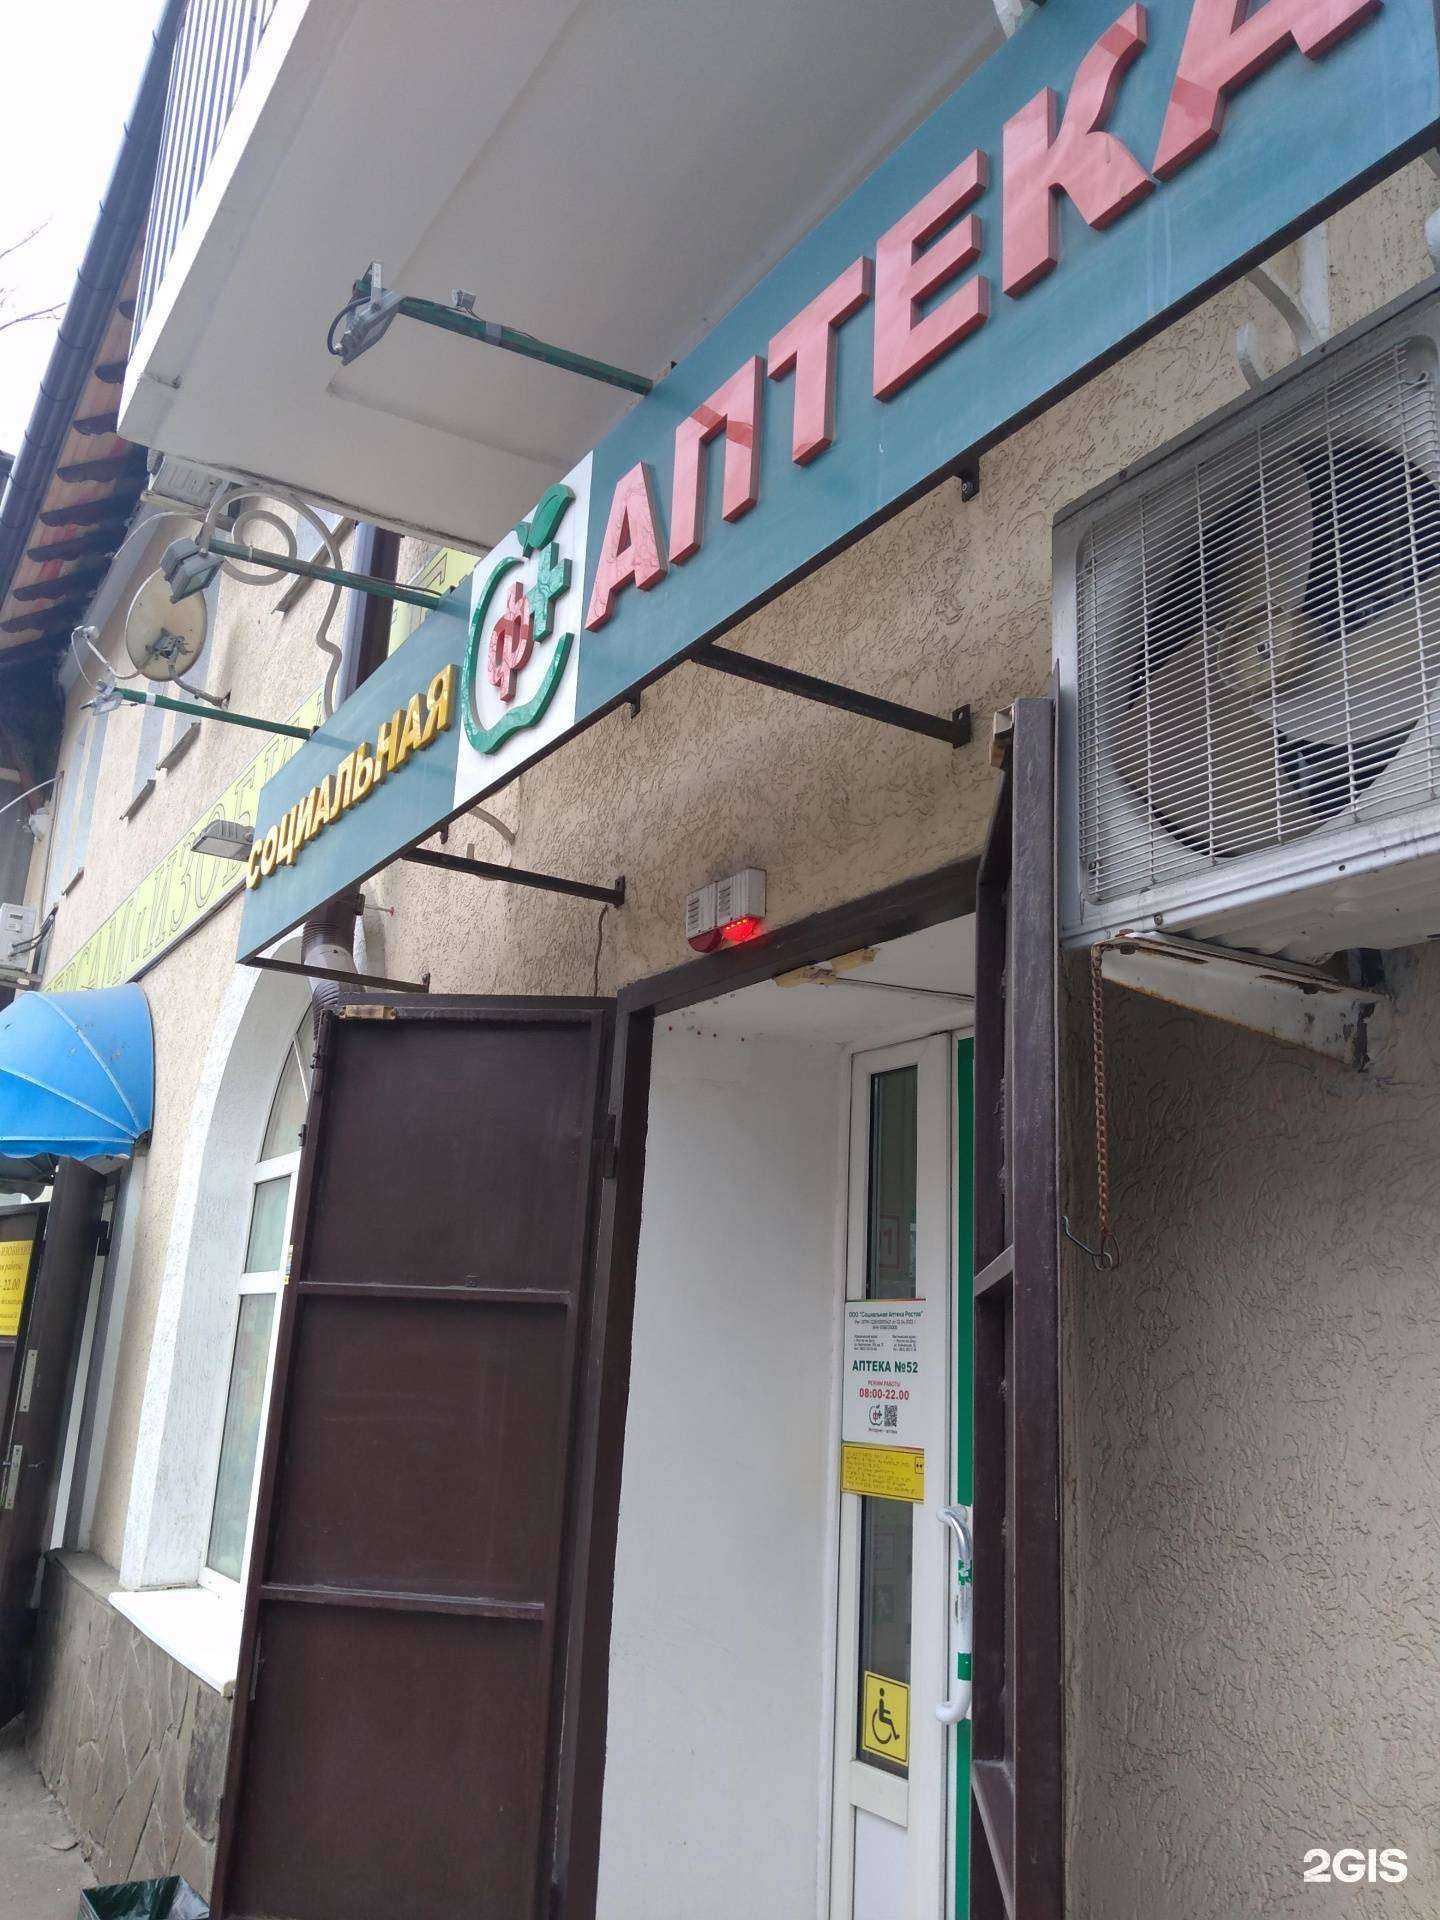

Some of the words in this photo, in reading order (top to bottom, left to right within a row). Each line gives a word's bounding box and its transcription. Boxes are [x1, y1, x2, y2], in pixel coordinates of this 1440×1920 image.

[586, 0, 1384, 633] АПТЕКА
[246, 664, 460, 890] СОЦИАЛЬНАЯ
[852, 1360, 891, 1372] АПТЕКА
[894, 1361, 918, 1374] №52
